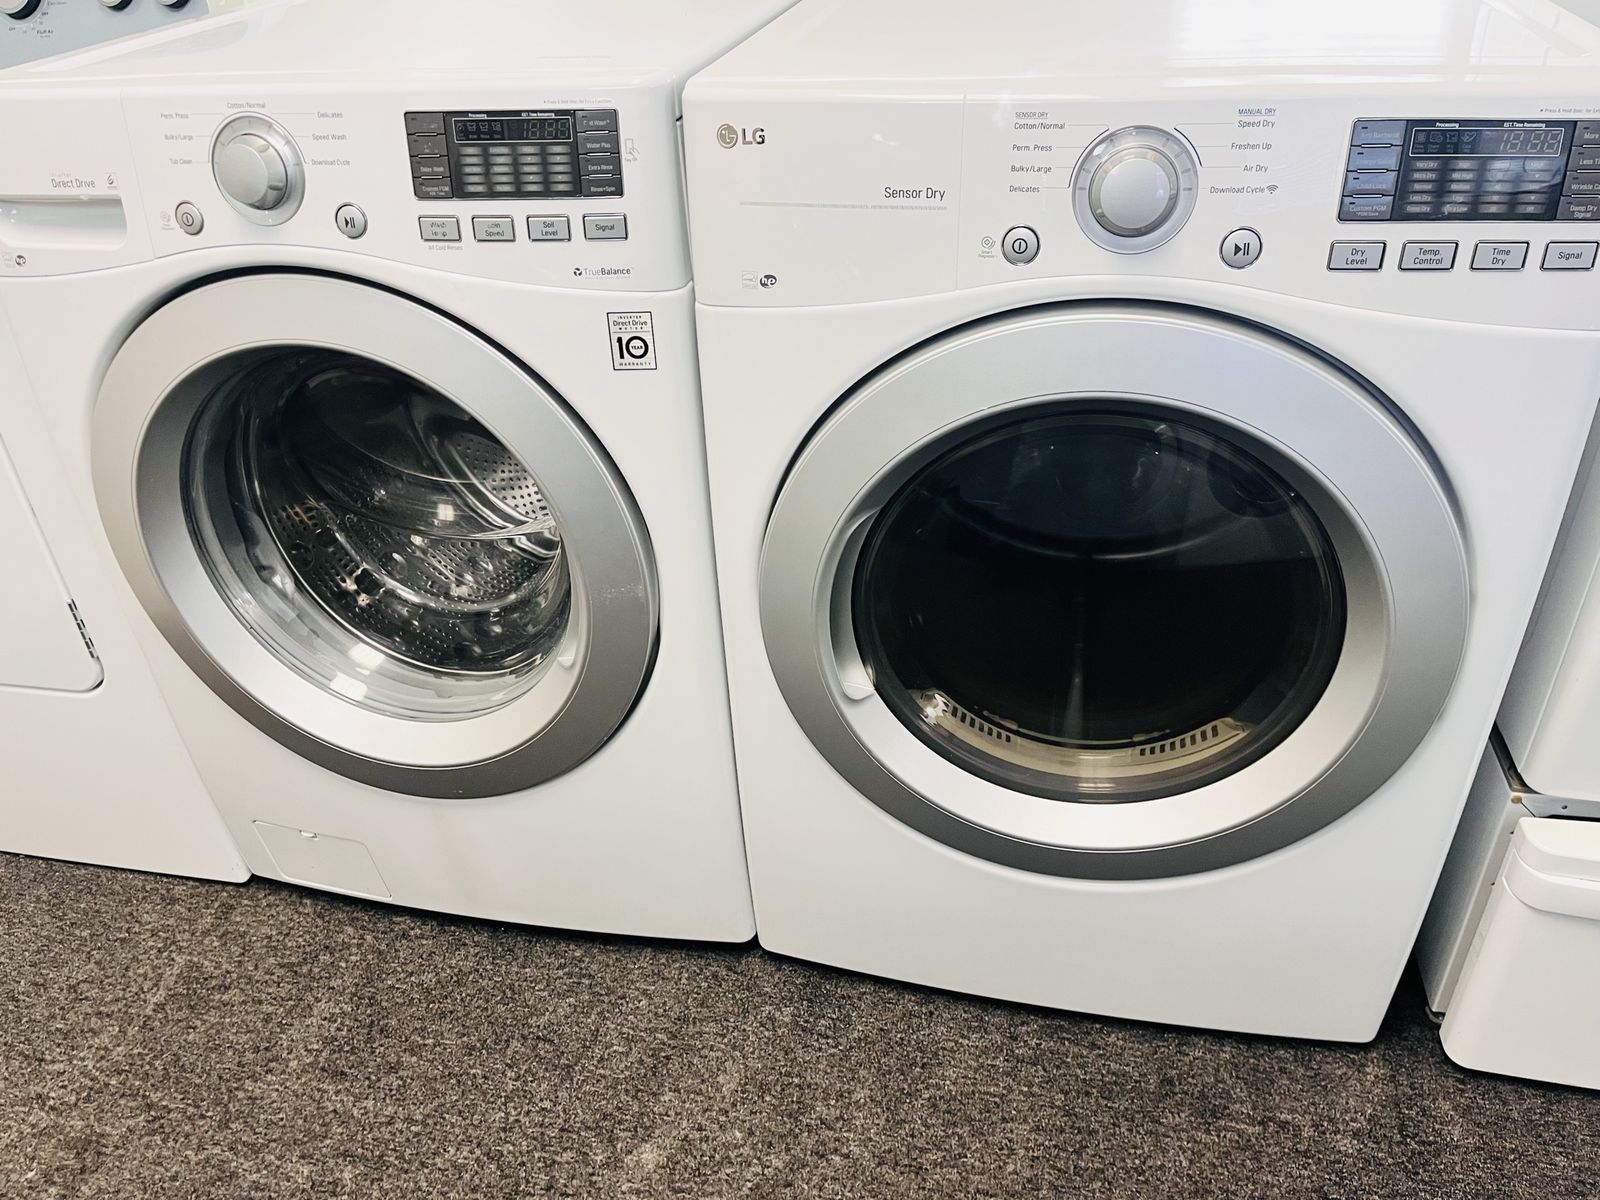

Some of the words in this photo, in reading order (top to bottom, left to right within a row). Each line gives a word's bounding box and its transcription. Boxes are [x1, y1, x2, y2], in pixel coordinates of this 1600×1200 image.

[1238, 120, 1261, 128] Speed
[1262, 120, 1276, 128] Dry
[741, 127, 766, 145] LG
[1033, 144, 1052, 152] Press
[1230, 142, 1260, 150] Freshen
[1262, 142, 1272, 150] Up
[1010, 164, 1052, 174] Bulky/Large
[1243, 164, 1254, 172] Air
[1255, 164, 1268, 173] Dry
[50, 178, 75, 189] Direct
[75, 178, 96, 188] Drive
[884, 186, 923, 199] Sensor
[926, 187, 946, 202] Dry
[1210, 186, 1244, 194] Download
[1245, 186, 1265, 195] Cycle
[1587, 204, 1598, 212] Dry
[595, 224, 615, 232] Signal
[1350, 248, 1366, 258] Dry
[1557, 252, 1583, 260] Signal
[1491, 258, 1506, 266] Dry
[616, 336, 649, 360] 10
